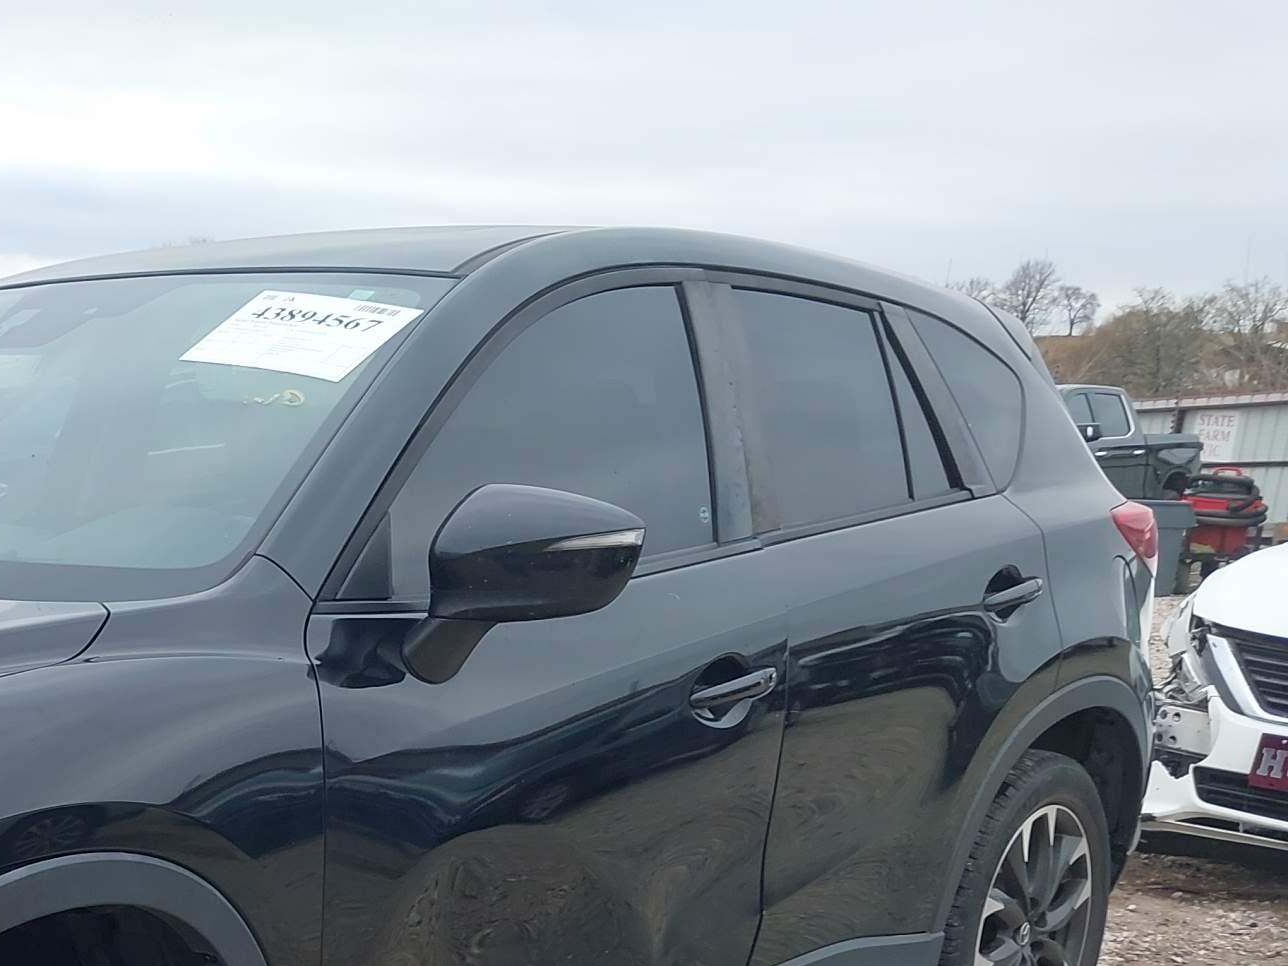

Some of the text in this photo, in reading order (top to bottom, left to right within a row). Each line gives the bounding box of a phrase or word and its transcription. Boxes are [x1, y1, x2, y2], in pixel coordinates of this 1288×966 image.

[251, 305, 385, 333] 43894567
[1199, 415, 1235, 427] STATE
[1256, 747, 1288, 779] H
